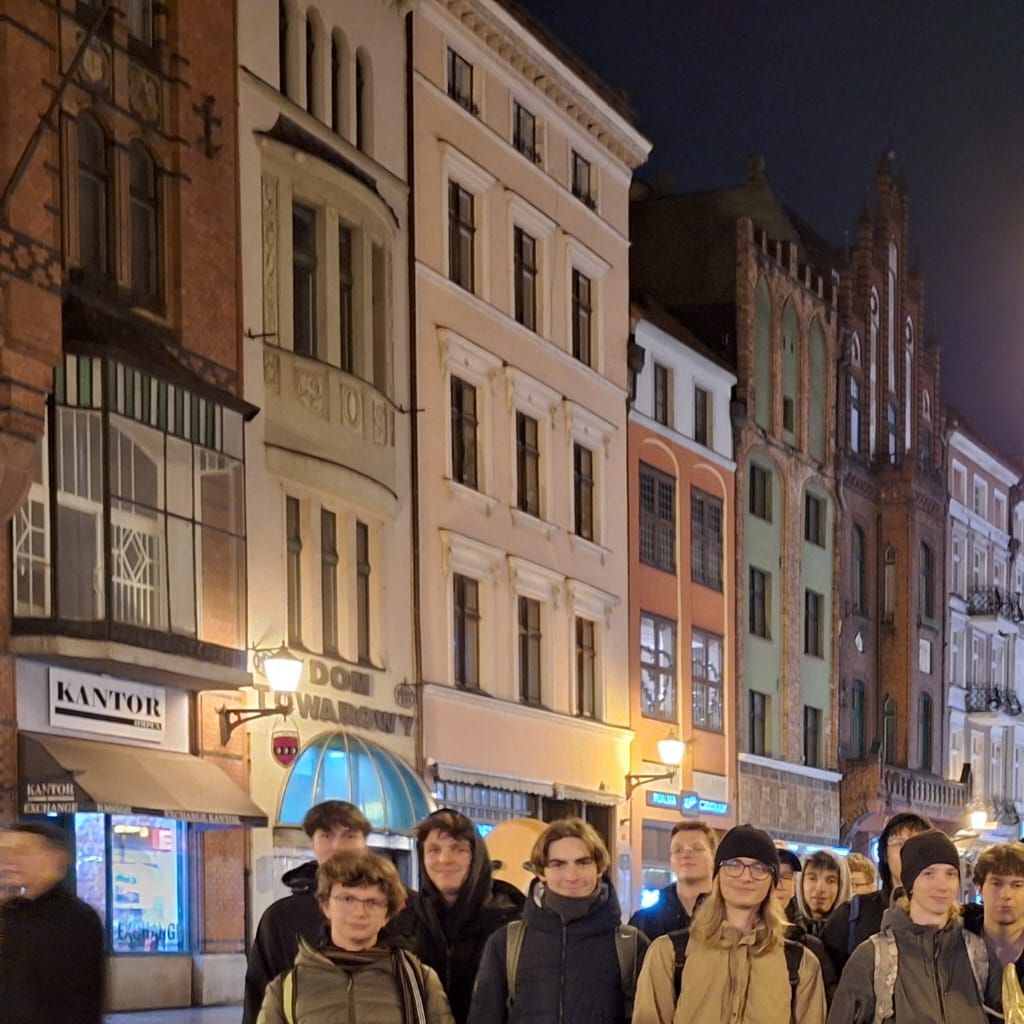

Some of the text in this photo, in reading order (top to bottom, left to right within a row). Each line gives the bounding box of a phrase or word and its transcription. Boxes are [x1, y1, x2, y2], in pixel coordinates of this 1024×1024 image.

[310, 659, 370, 697] DOM
[57, 681, 161, 718] KANTOR
[27, 783, 74, 797] KANTOR
[24, 803, 78, 814] EXCHANGE
